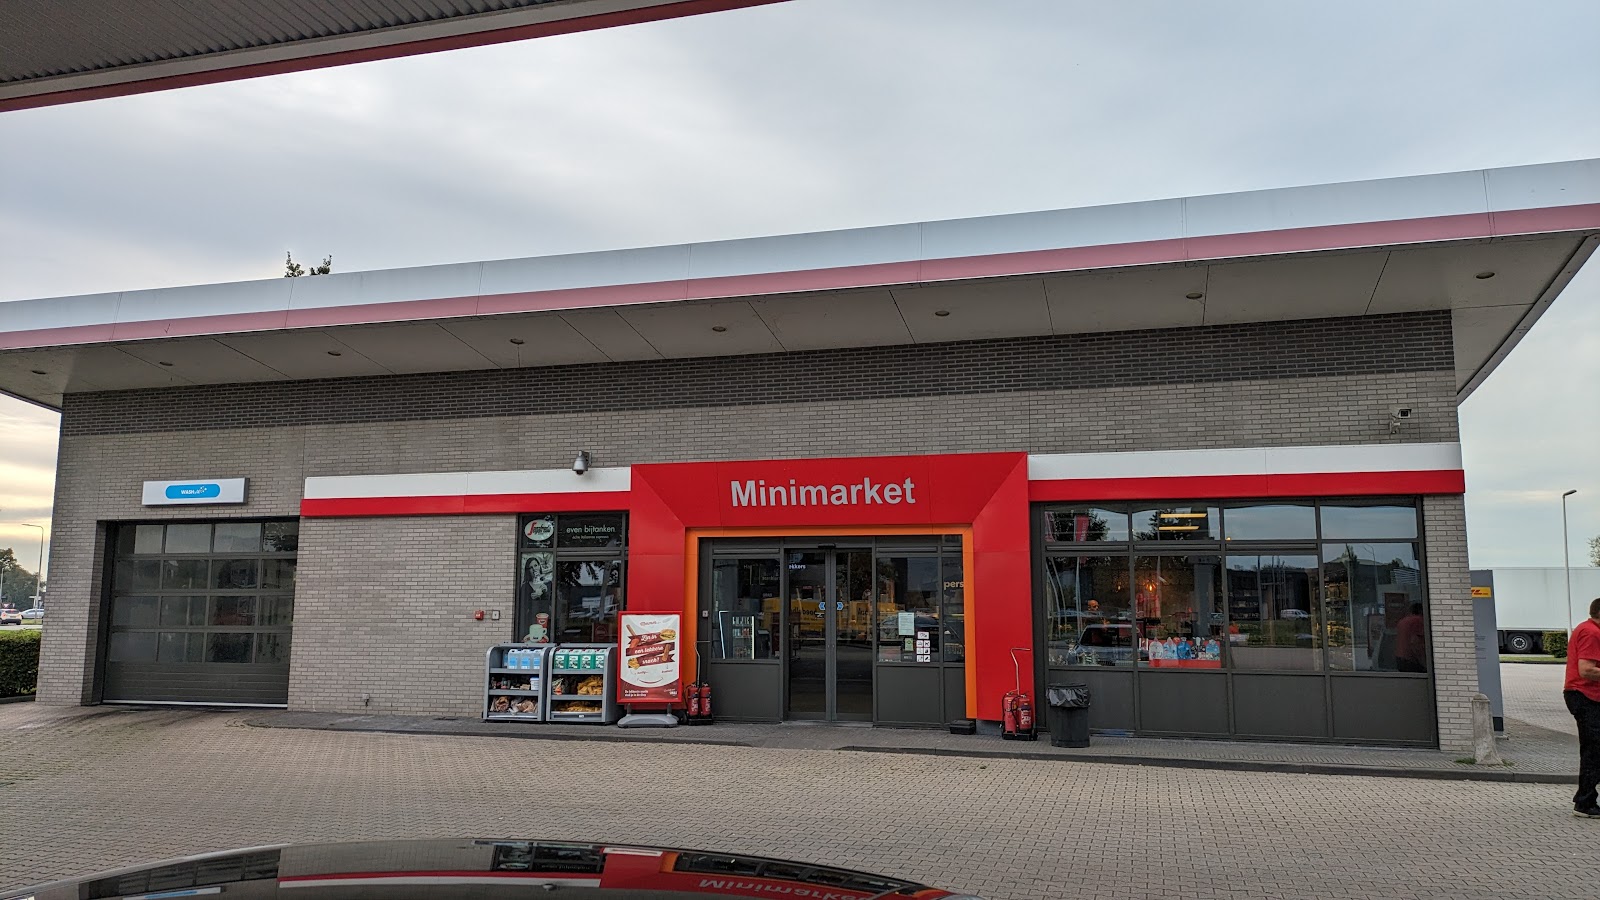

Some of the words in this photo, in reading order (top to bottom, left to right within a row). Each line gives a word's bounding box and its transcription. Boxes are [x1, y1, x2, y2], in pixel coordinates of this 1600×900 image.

[730, 477, 916, 507] Minimarket
[584, 524, 616, 535] bijtanken
[943, 581, 964, 590] pers
